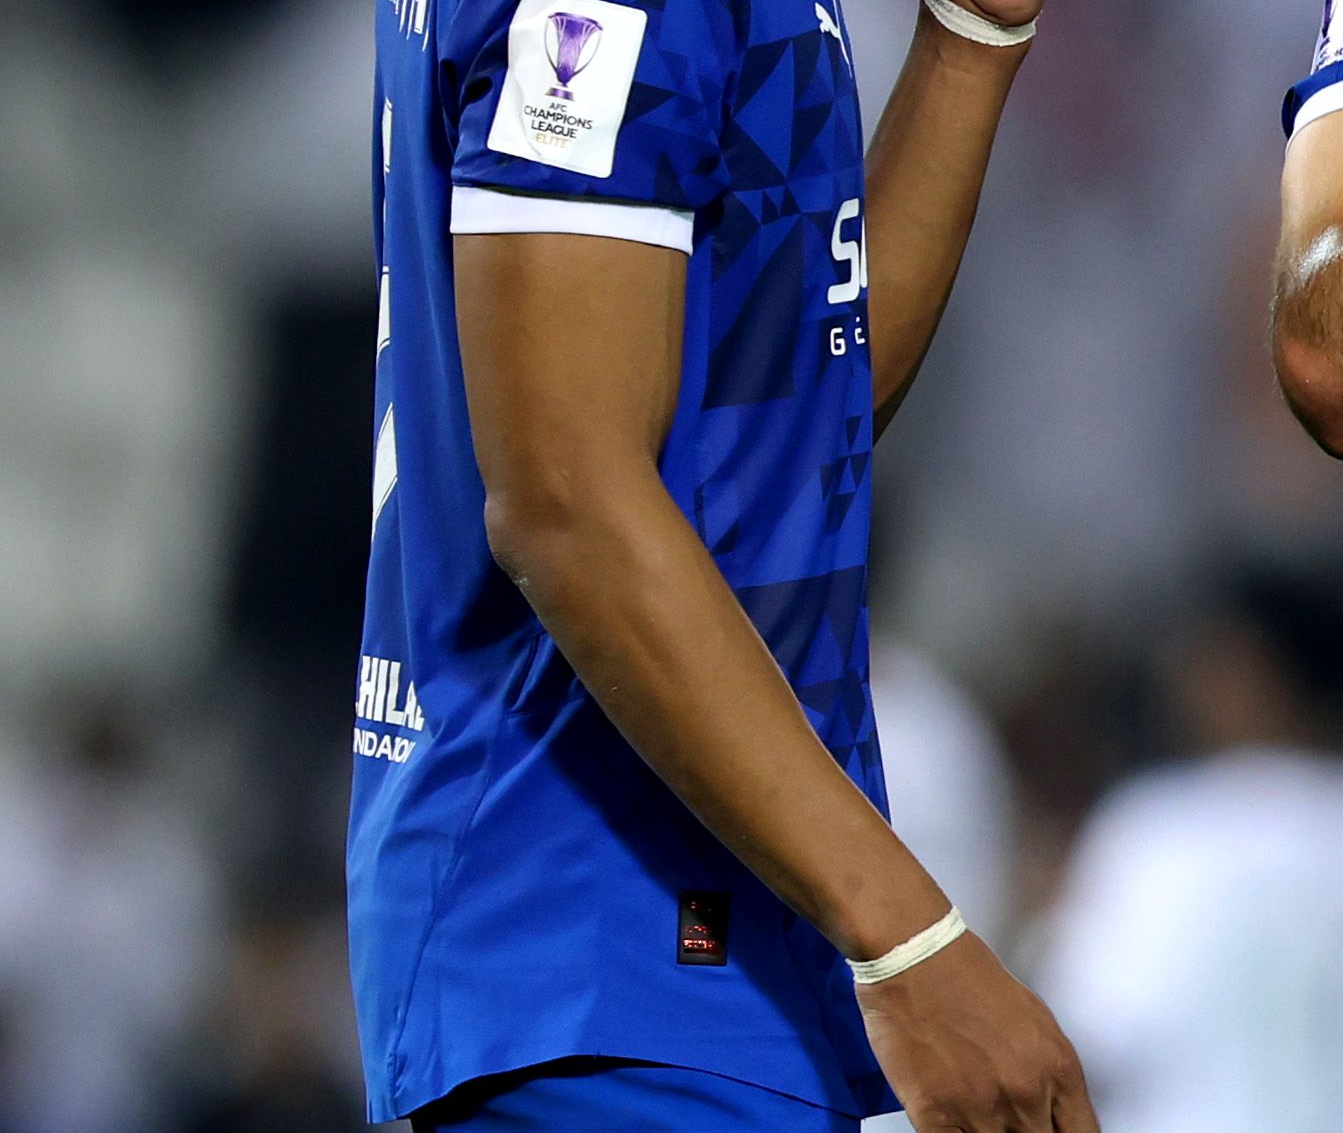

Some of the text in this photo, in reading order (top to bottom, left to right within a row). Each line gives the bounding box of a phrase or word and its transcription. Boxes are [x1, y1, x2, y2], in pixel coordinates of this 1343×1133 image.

[549, 102, 568, 113] AFC
[523, 105, 593, 130] CHAMPIONS
[530, 119, 578, 139] LEAGUE
[535, 132, 573, 148] ELITE
